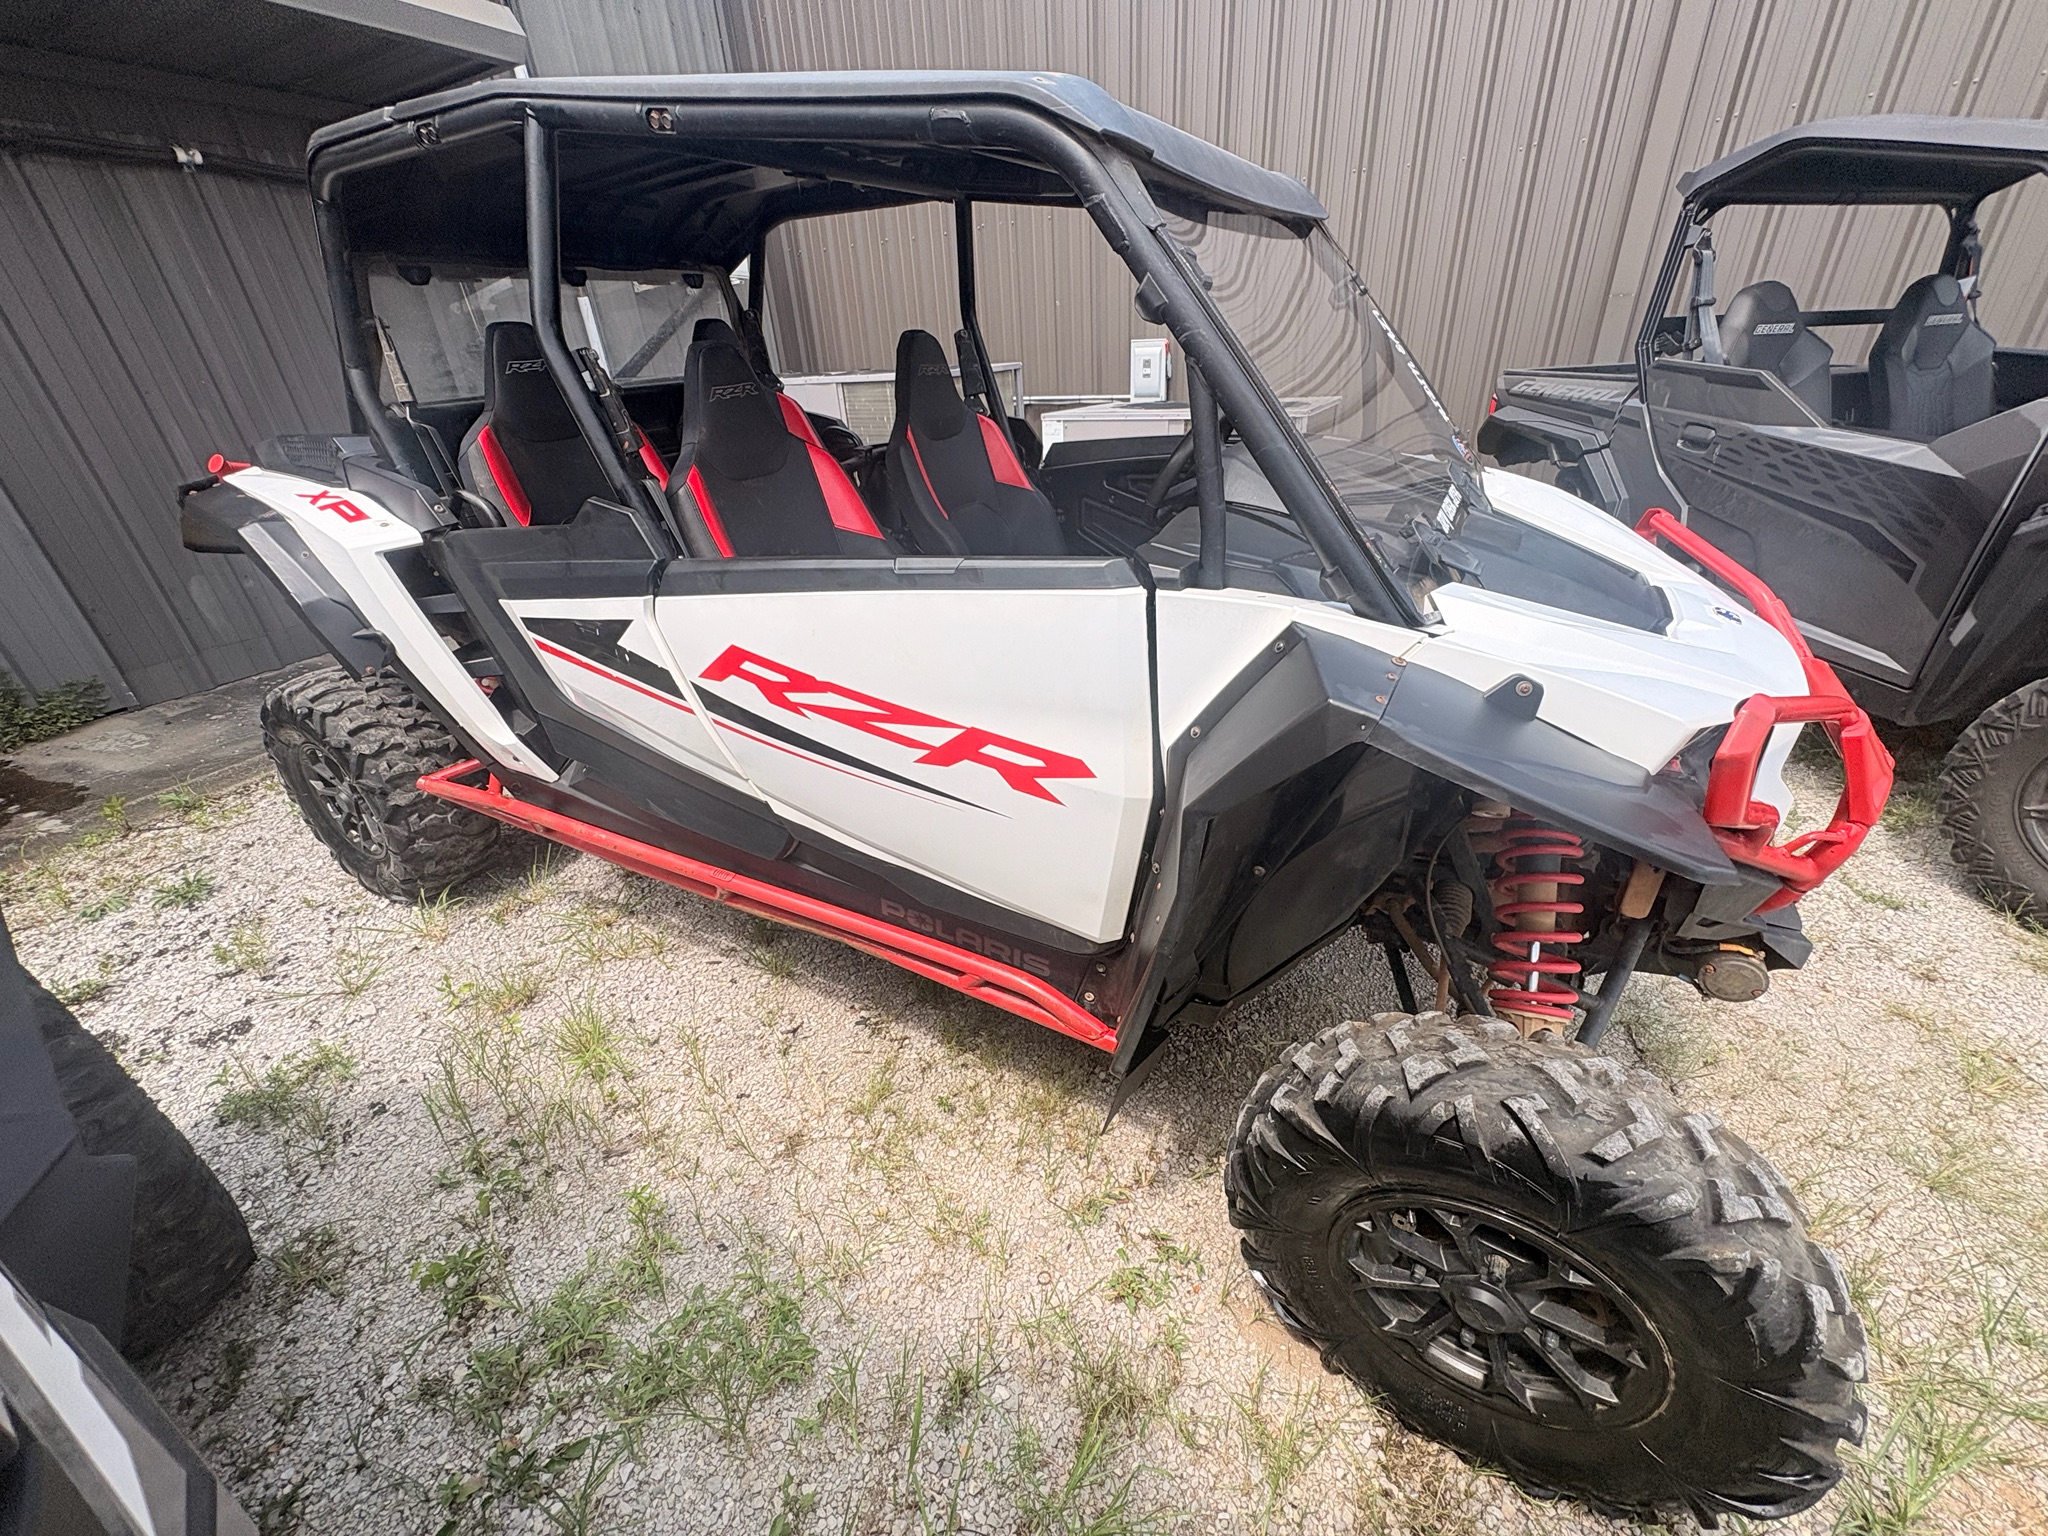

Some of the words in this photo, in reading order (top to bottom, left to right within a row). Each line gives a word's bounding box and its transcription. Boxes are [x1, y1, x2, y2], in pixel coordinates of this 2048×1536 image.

[1753, 322, 1796, 335] GENERAL
[918, 363, 950, 376] RZR
[709, 382, 759, 402] RZR
[1509, 380, 1620, 402] GENERAL
[295, 490, 372, 523] XP
[698, 644, 1098, 807] RZR
[880, 898, 1051, 978] POLARIS
